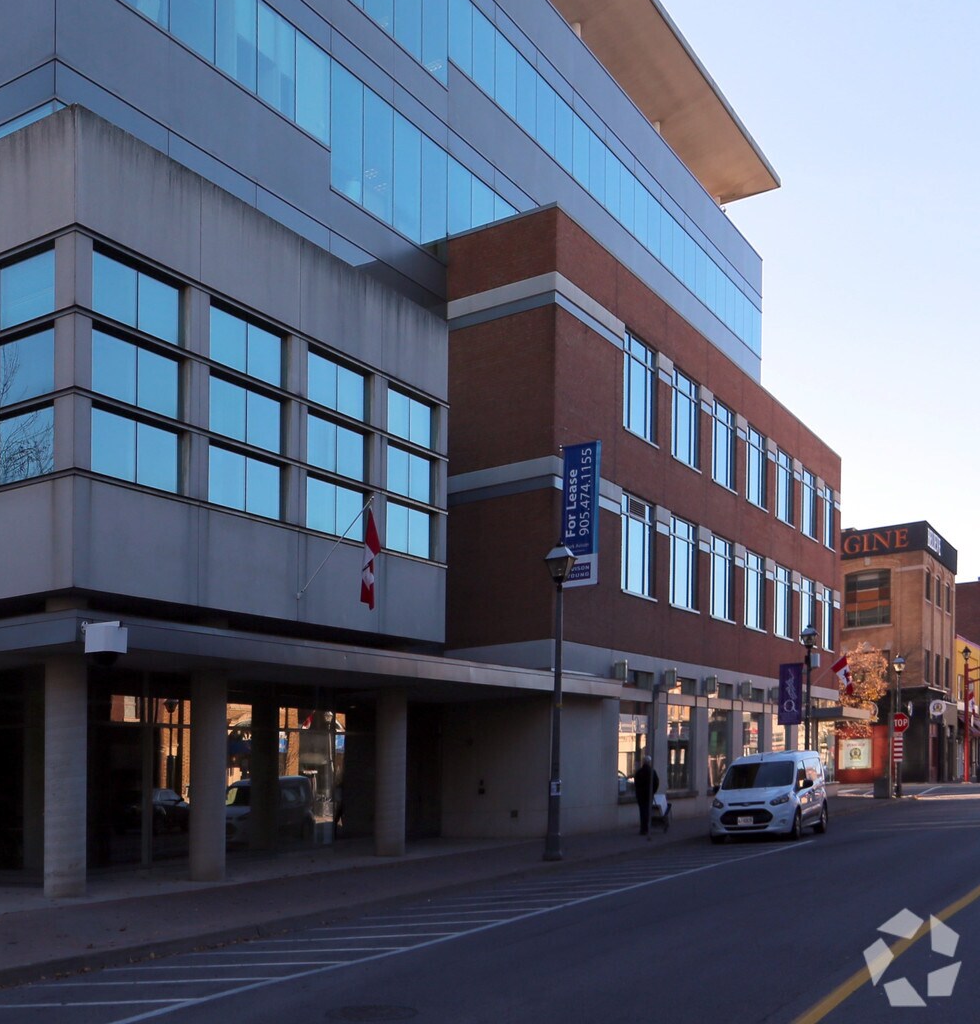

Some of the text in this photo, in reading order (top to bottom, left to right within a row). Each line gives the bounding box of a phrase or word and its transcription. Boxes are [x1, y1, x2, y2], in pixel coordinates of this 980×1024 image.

[565, 469, 578, 538] For Lease
[579, 448, 592, 536] 905.474.1155
[843, 528, 908, 554] GINE
[894, 718, 908, 727] TOP
